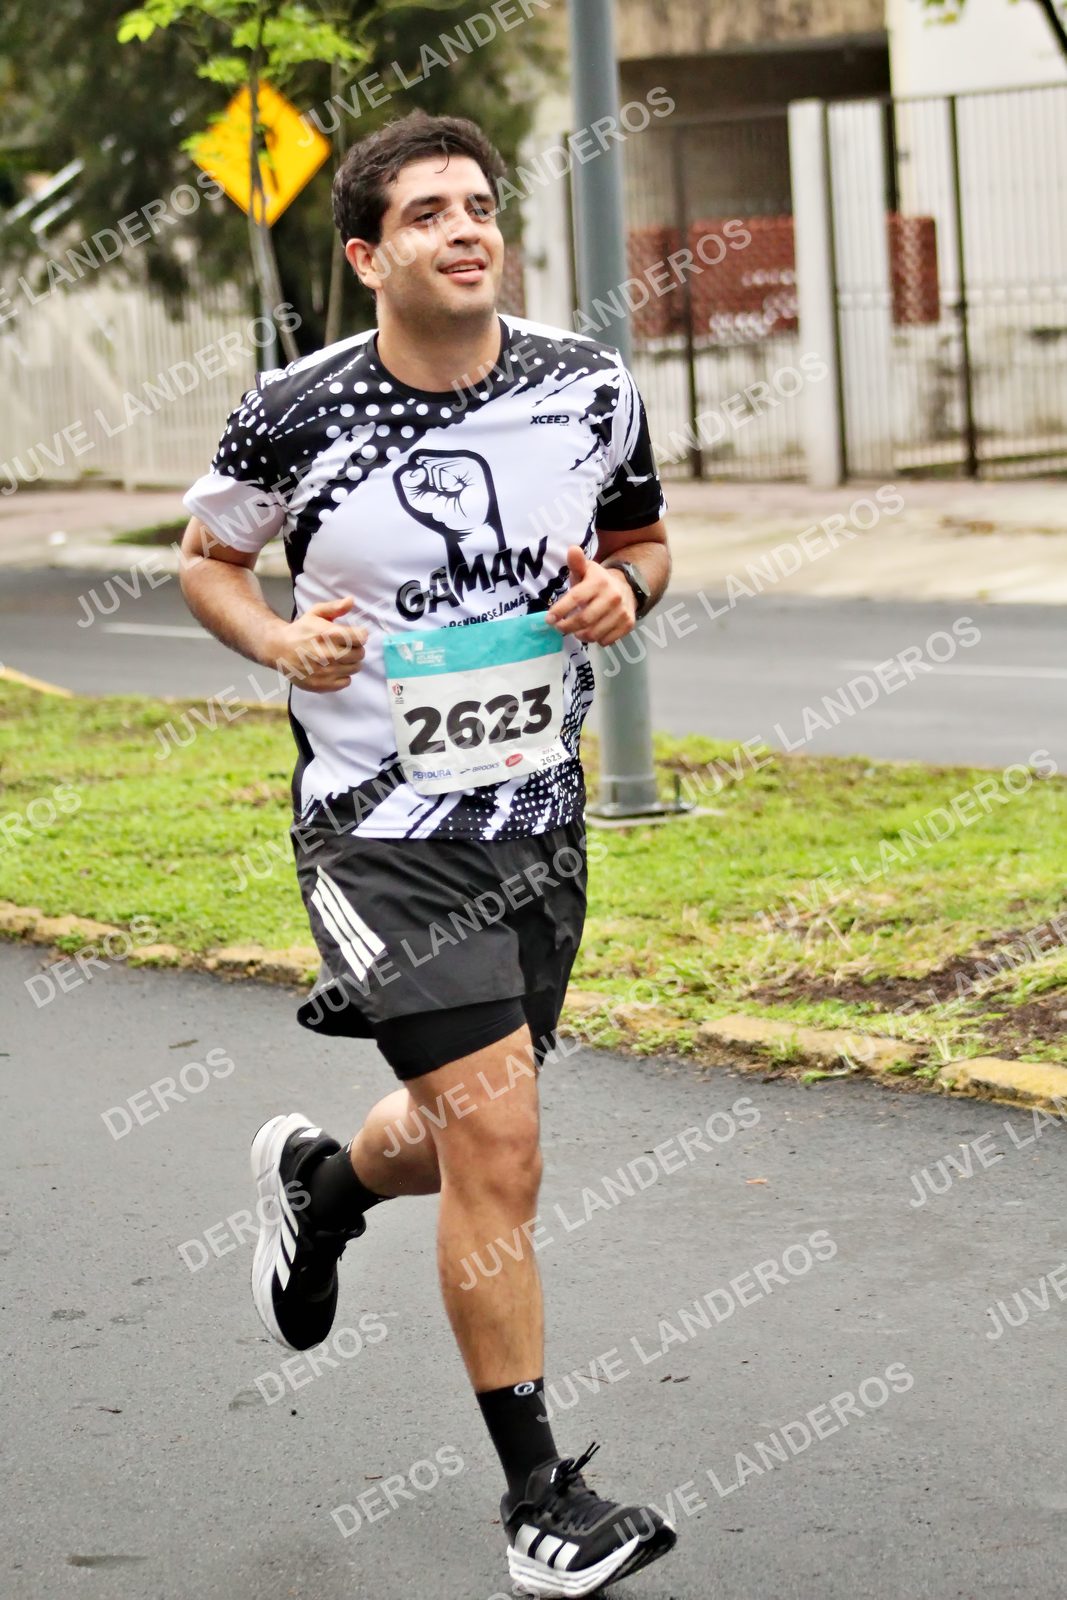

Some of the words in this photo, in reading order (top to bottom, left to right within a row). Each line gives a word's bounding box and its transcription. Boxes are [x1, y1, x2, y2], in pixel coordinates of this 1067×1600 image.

[530, 415, 569, 424] XCEED
[396, 536, 548, 621] GAMAN
[404, 684, 552, 755] 2623
[541, 752, 562, 766] 2623
